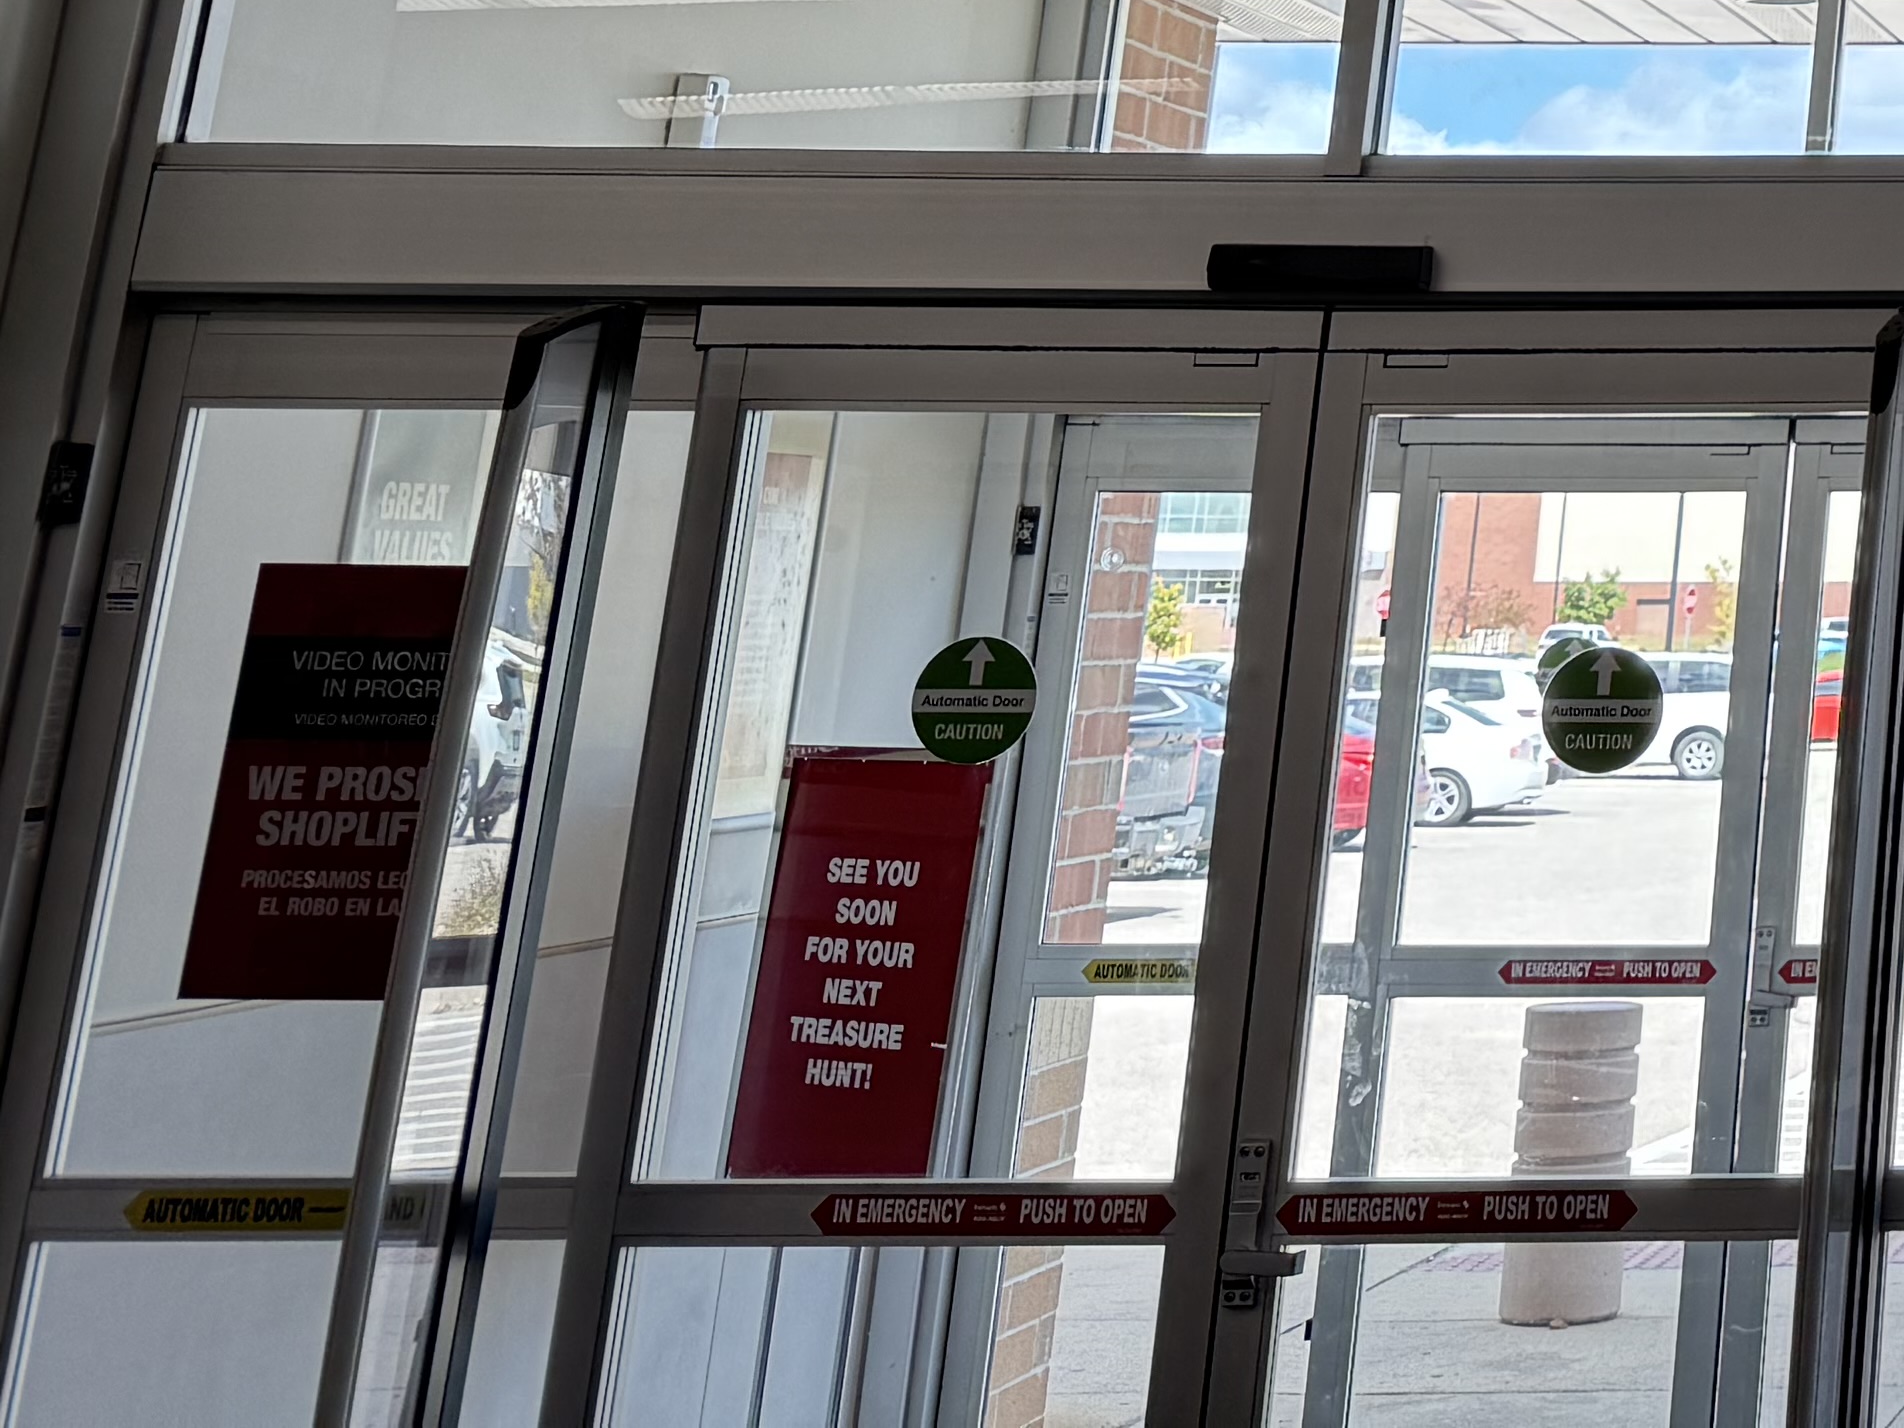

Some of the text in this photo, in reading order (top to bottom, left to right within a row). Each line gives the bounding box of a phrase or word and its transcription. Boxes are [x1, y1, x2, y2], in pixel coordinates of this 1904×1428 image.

[380, 481, 450, 521] GREAT
[293, 651, 363, 671] VIDEO
[322, 679, 346, 697] IN
[921, 694, 1025, 708] Automatic Door
[1552, 705, 1652, 717] Automatic Door
[294, 713, 427, 726] VIDEO MONITOREO
[935, 723, 1003, 741] CAUTION
[1565, 734, 1633, 750] CAUTION
[249, 765, 306, 801] WE
[241, 870, 371, 889] PROCESAMOS
[827, 857, 920, 887] SEE YOU
[258, 897, 401, 916] EL ROBO EN LA
[835, 898, 897, 926] SOON
[804, 937, 914, 968] FOR YOUR
[1094, 963, 1189, 979] AUTOMATIC DOOR
[1511, 960, 1524, 977] IN
[1525, 960, 1591, 978] EMERGENCY
[1623, 960, 1651, 977] PUSH
[1655, 960, 1668, 977] TO
[1671, 960, 1700, 978] OPEN
[823, 978, 882, 1006] NEXT
[790, 1016, 904, 1050] TREASURE
[805, 1058, 872, 1089] HUNT!
[142, 1197, 304, 1223] AUTOMATIC DOOR
[833, 1199, 852, 1223] IN
[857, 1198, 966, 1224] EMERGENCY
[1019, 1199, 1068, 1224] PUSH
[1074, 1199, 1095, 1224] TO
[1101, 1199, 1147, 1224] OPEN
[1299, 1198, 1316, 1223] IN
[1322, 1197, 1430, 1223] EMERGENCY
[1483, 1195, 1529, 1220] PUSH
[1535, 1194, 1557, 1220] TO
[1563, 1194, 1609, 1220] OPEN
